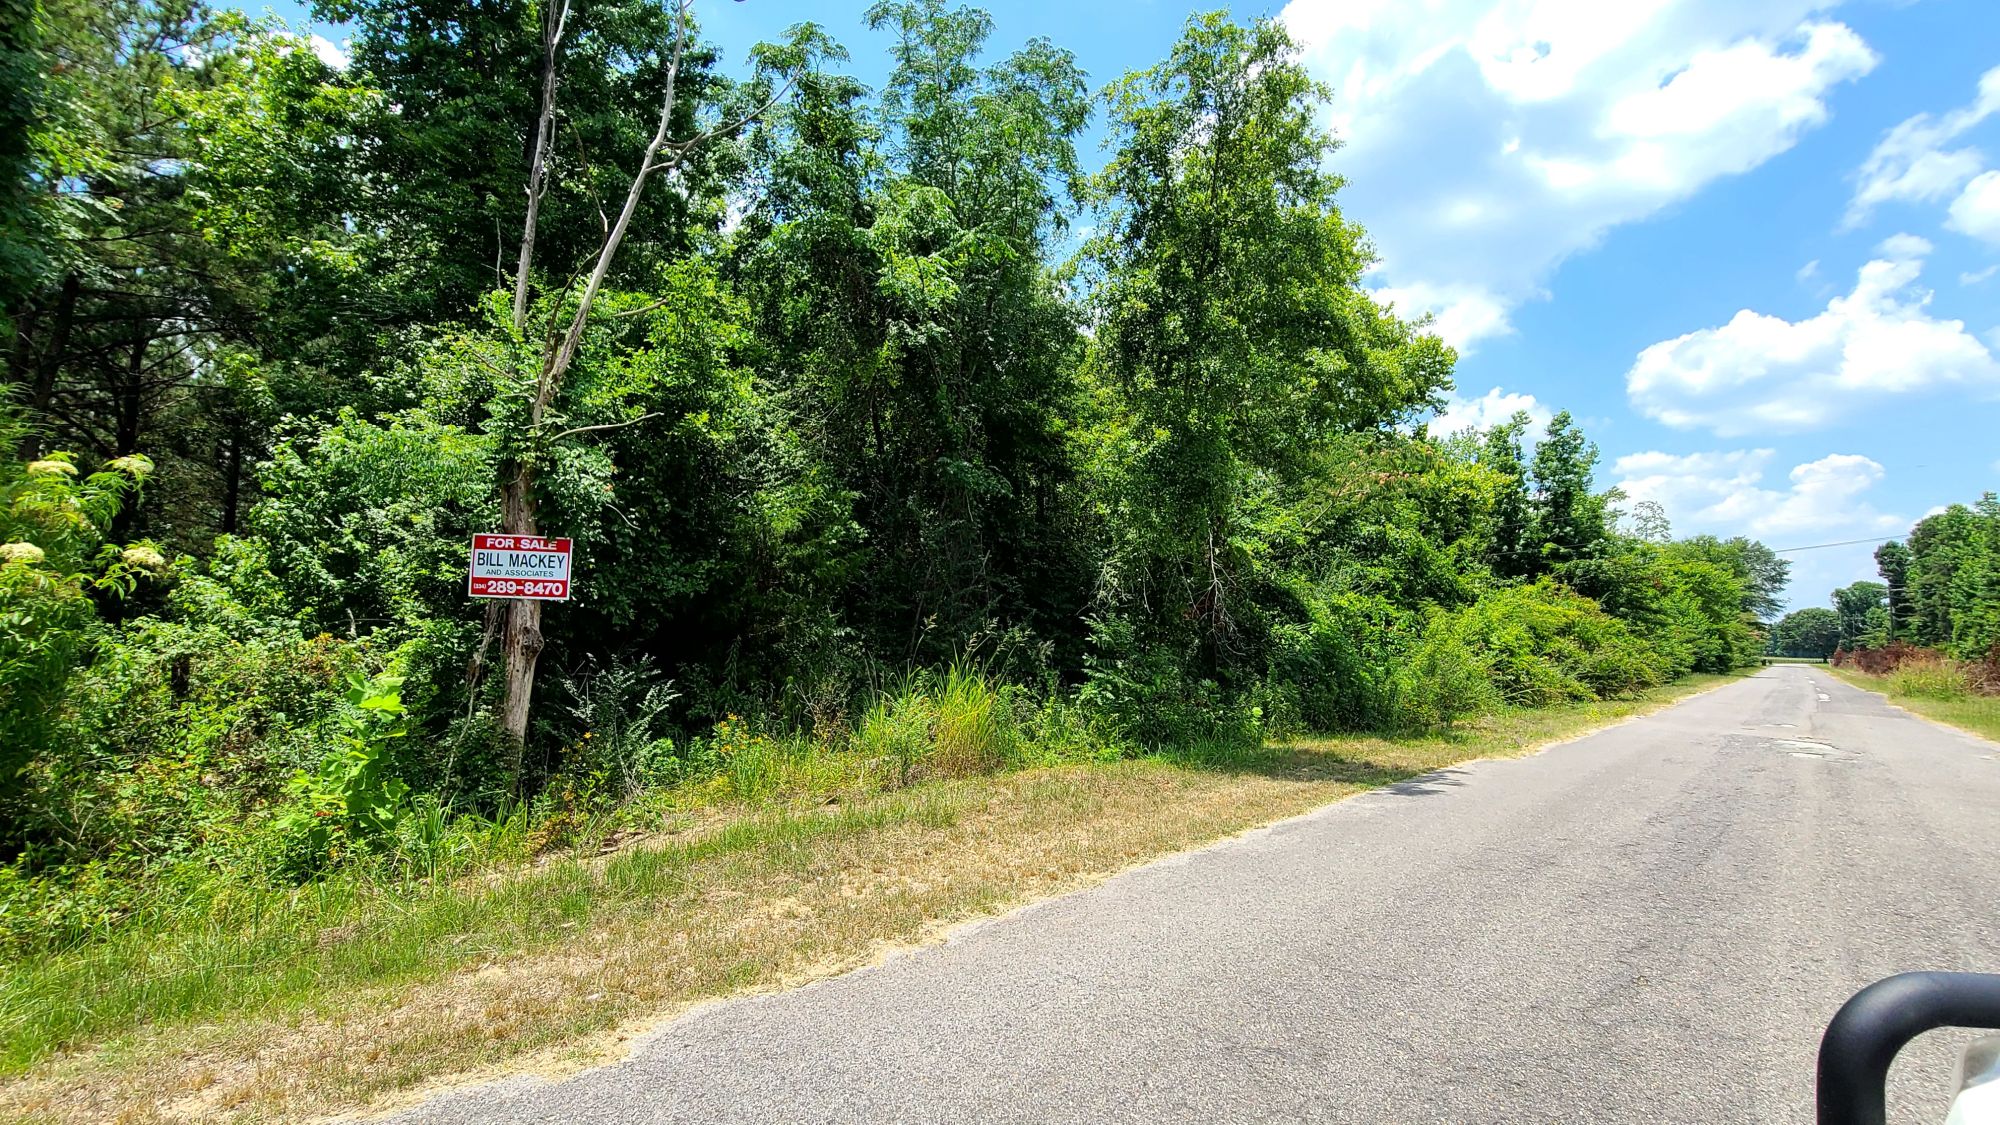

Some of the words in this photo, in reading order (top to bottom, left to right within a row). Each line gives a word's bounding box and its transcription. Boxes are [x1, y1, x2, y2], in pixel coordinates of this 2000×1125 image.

[486, 538, 515, 548] FOR
[520, 539, 557, 550] SALE
[477, 552, 503, 566] BILL
[509, 553, 565, 568] MACKEY
[504, 569, 554, 577] ASSOCIATES
[487, 580, 563, 595] 289-8470
